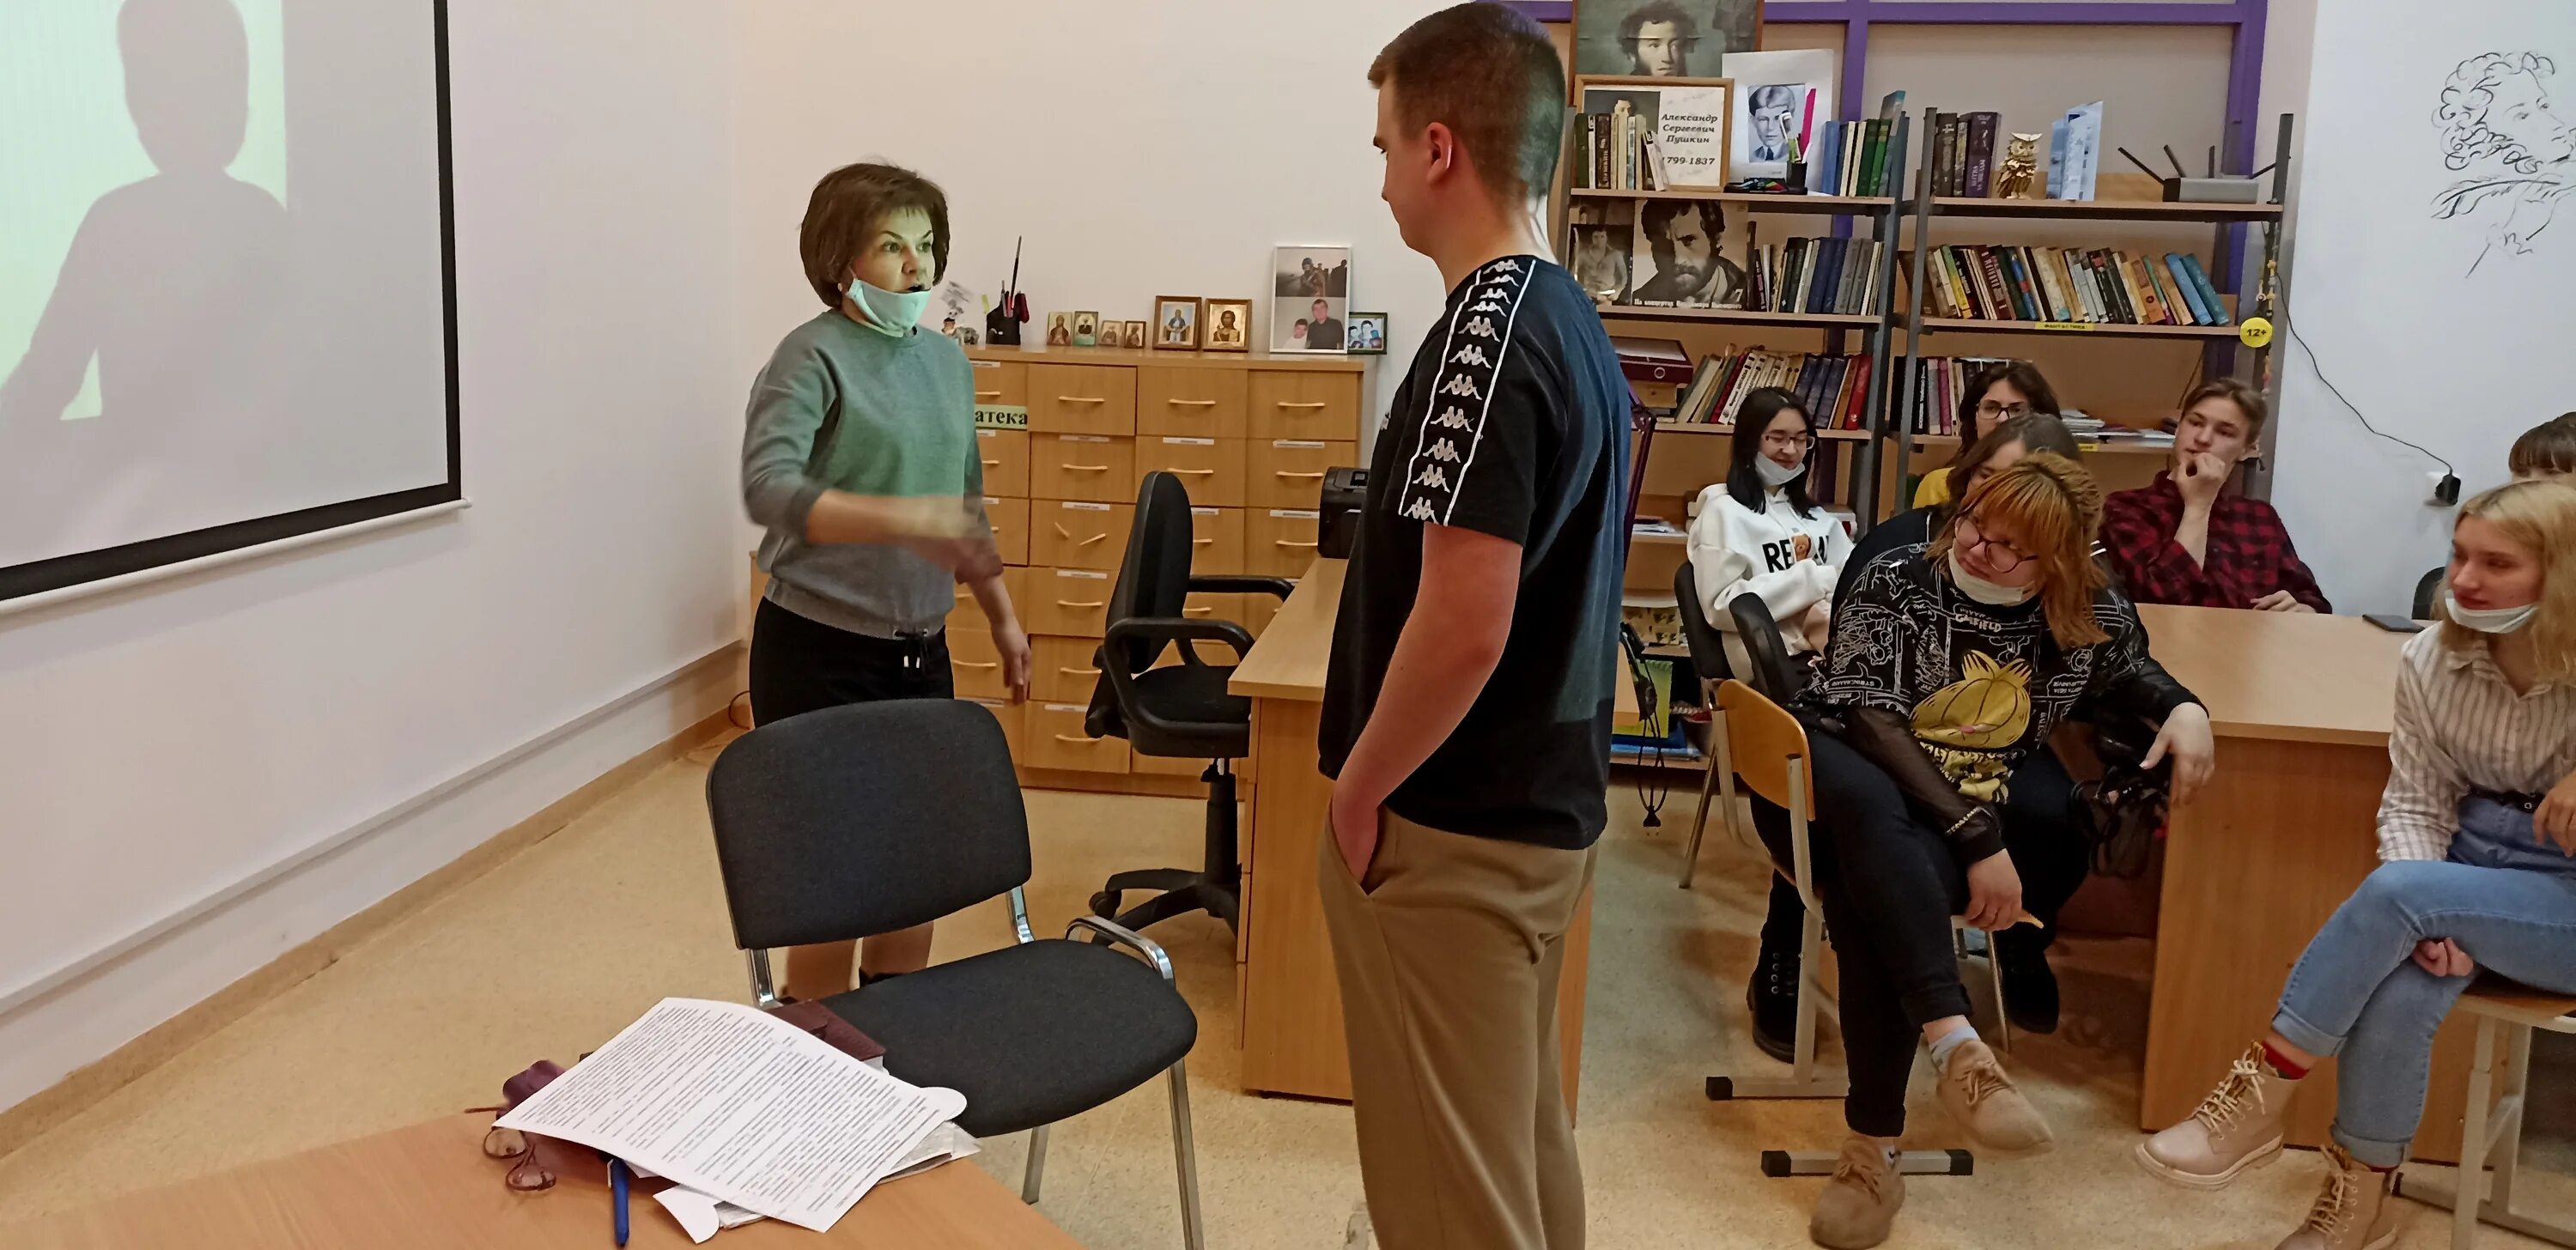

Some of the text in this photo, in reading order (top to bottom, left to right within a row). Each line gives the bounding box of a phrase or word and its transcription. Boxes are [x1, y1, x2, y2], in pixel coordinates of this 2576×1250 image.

[1661, 113, 1718, 124] Александр
[1662, 124, 1715, 133] Сергеевич
[1666, 135, 1710, 144] Пушкин
[2246, 328, 2267, 337] 12+
[975, 410, 1028, 425] атека
